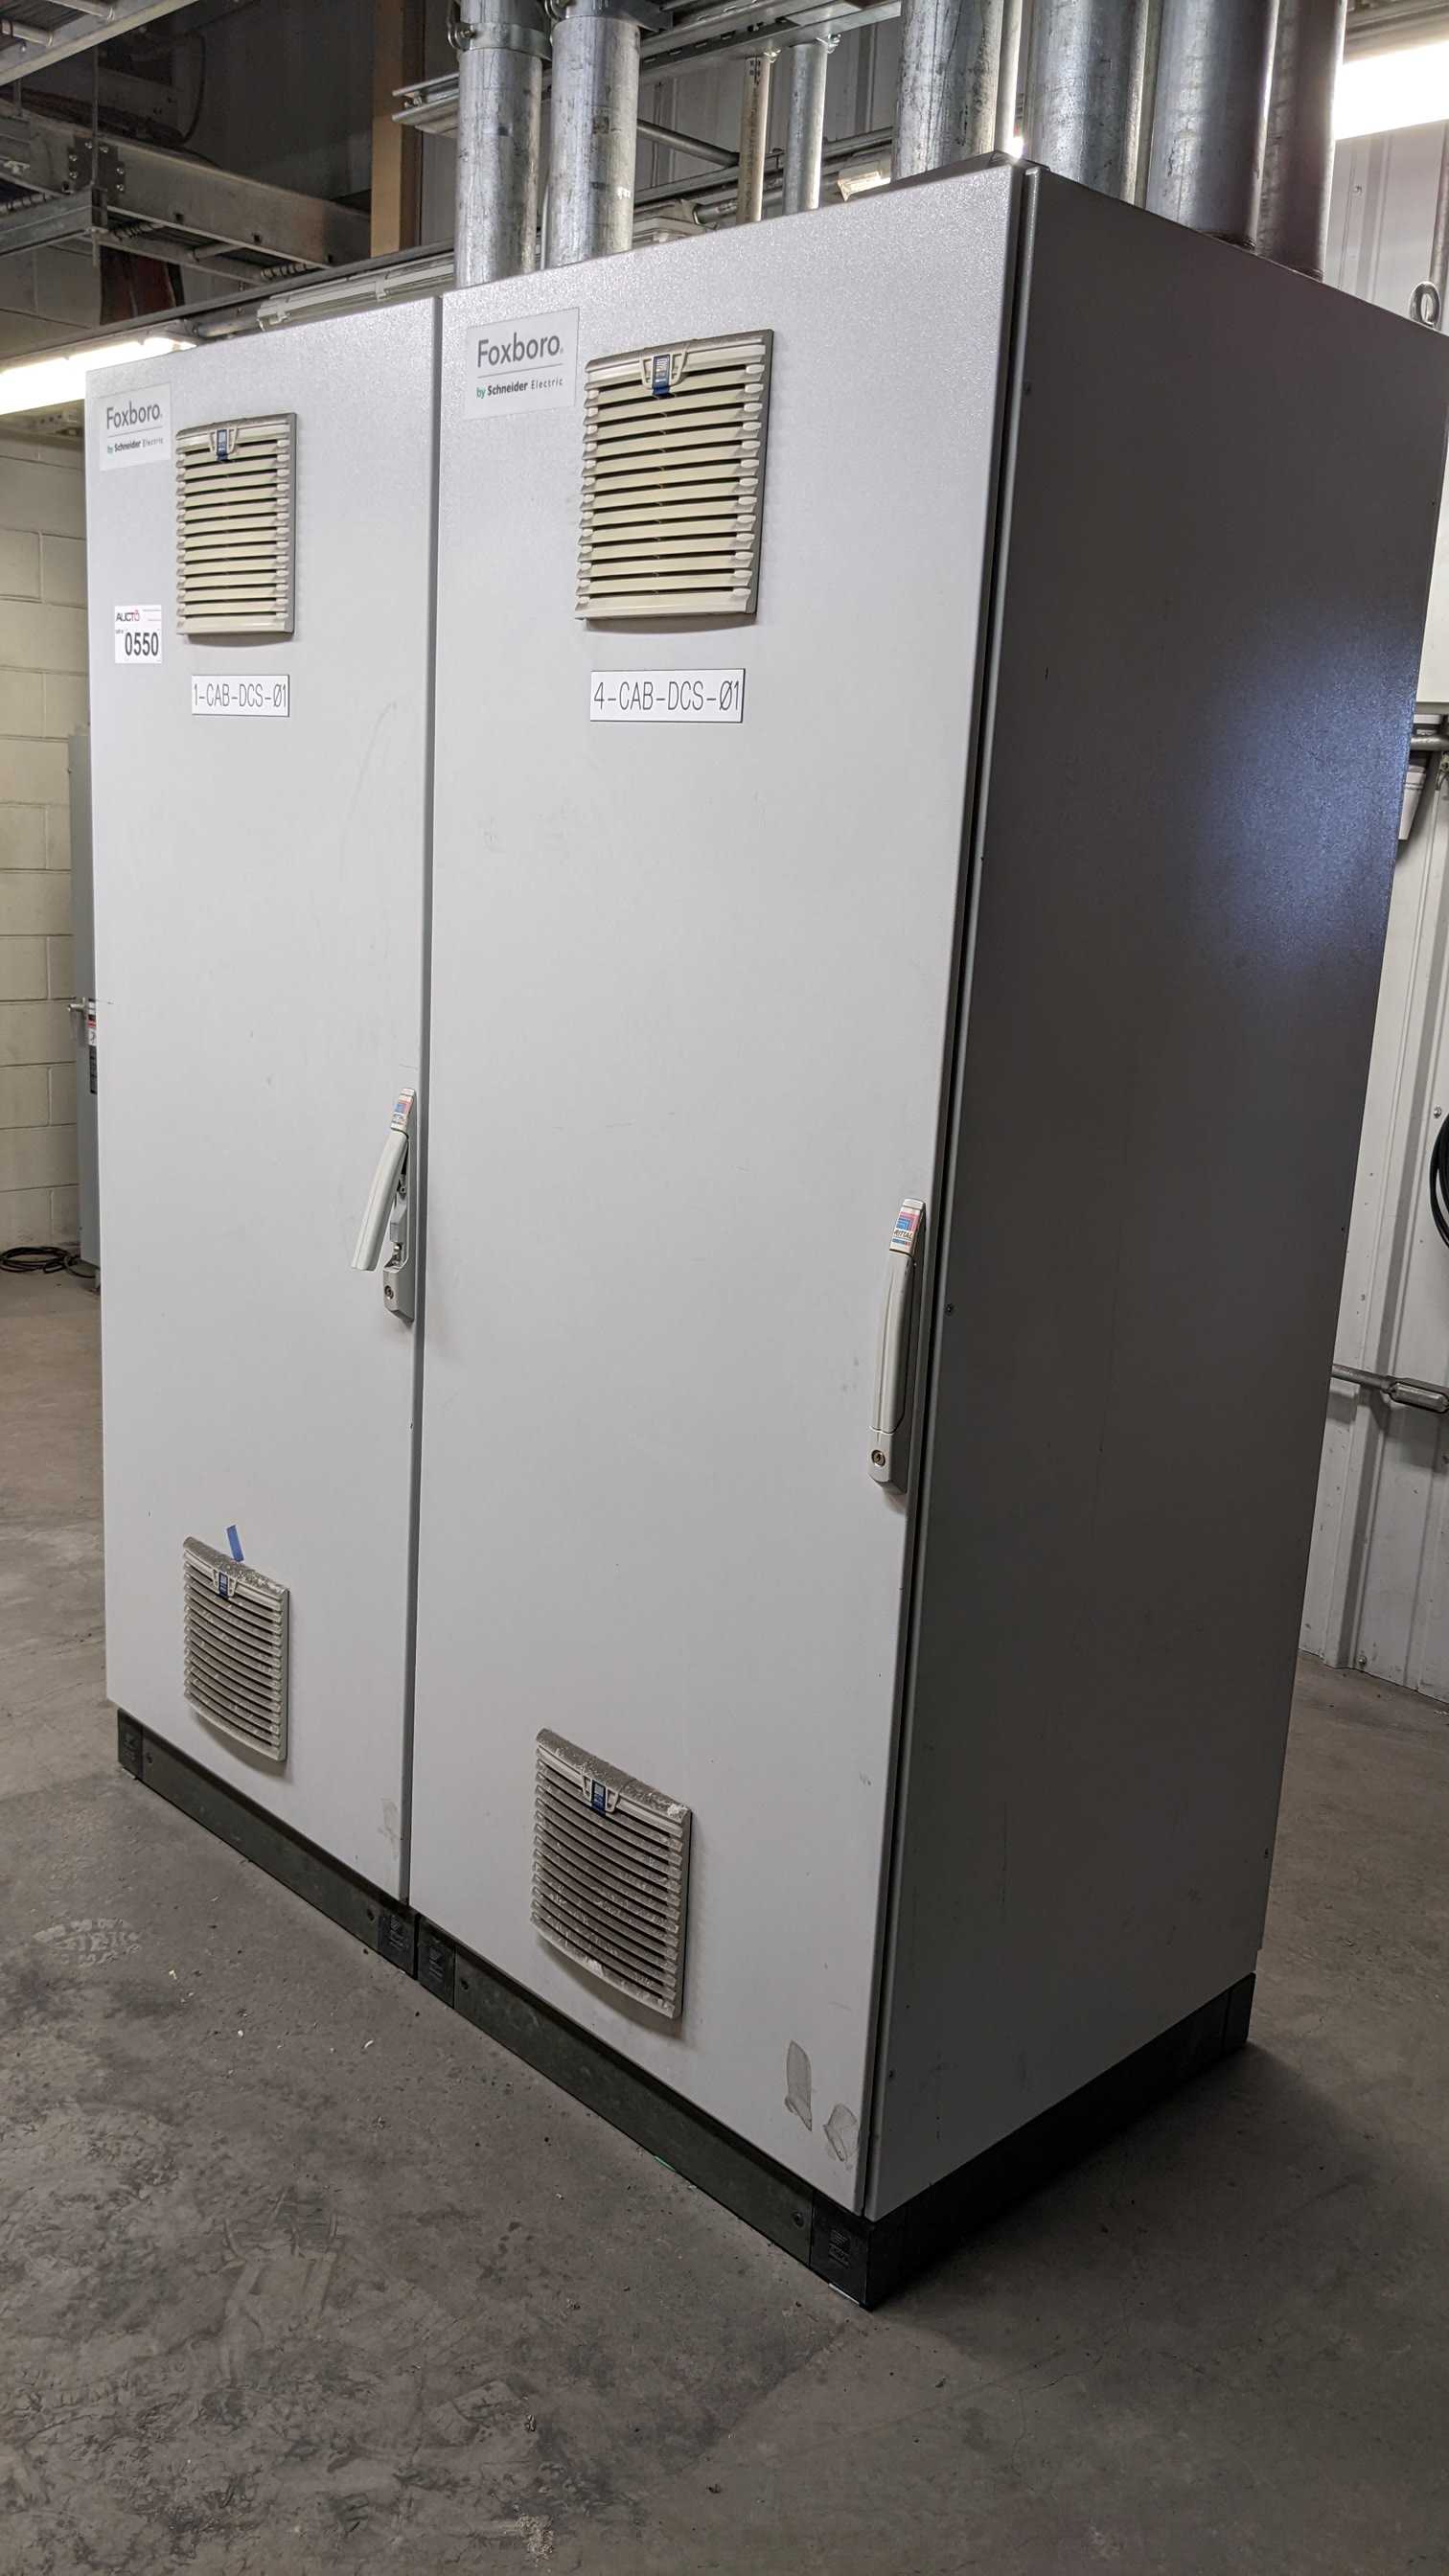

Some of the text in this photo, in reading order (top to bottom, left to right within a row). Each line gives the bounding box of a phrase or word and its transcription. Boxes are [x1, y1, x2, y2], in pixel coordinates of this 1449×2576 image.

[477, 332, 561, 368] Foxboro
[476, 378, 564, 399] by Schneider Electric
[106, 401, 161, 429] Foxboro
[125, 632, 159, 656] 0550
